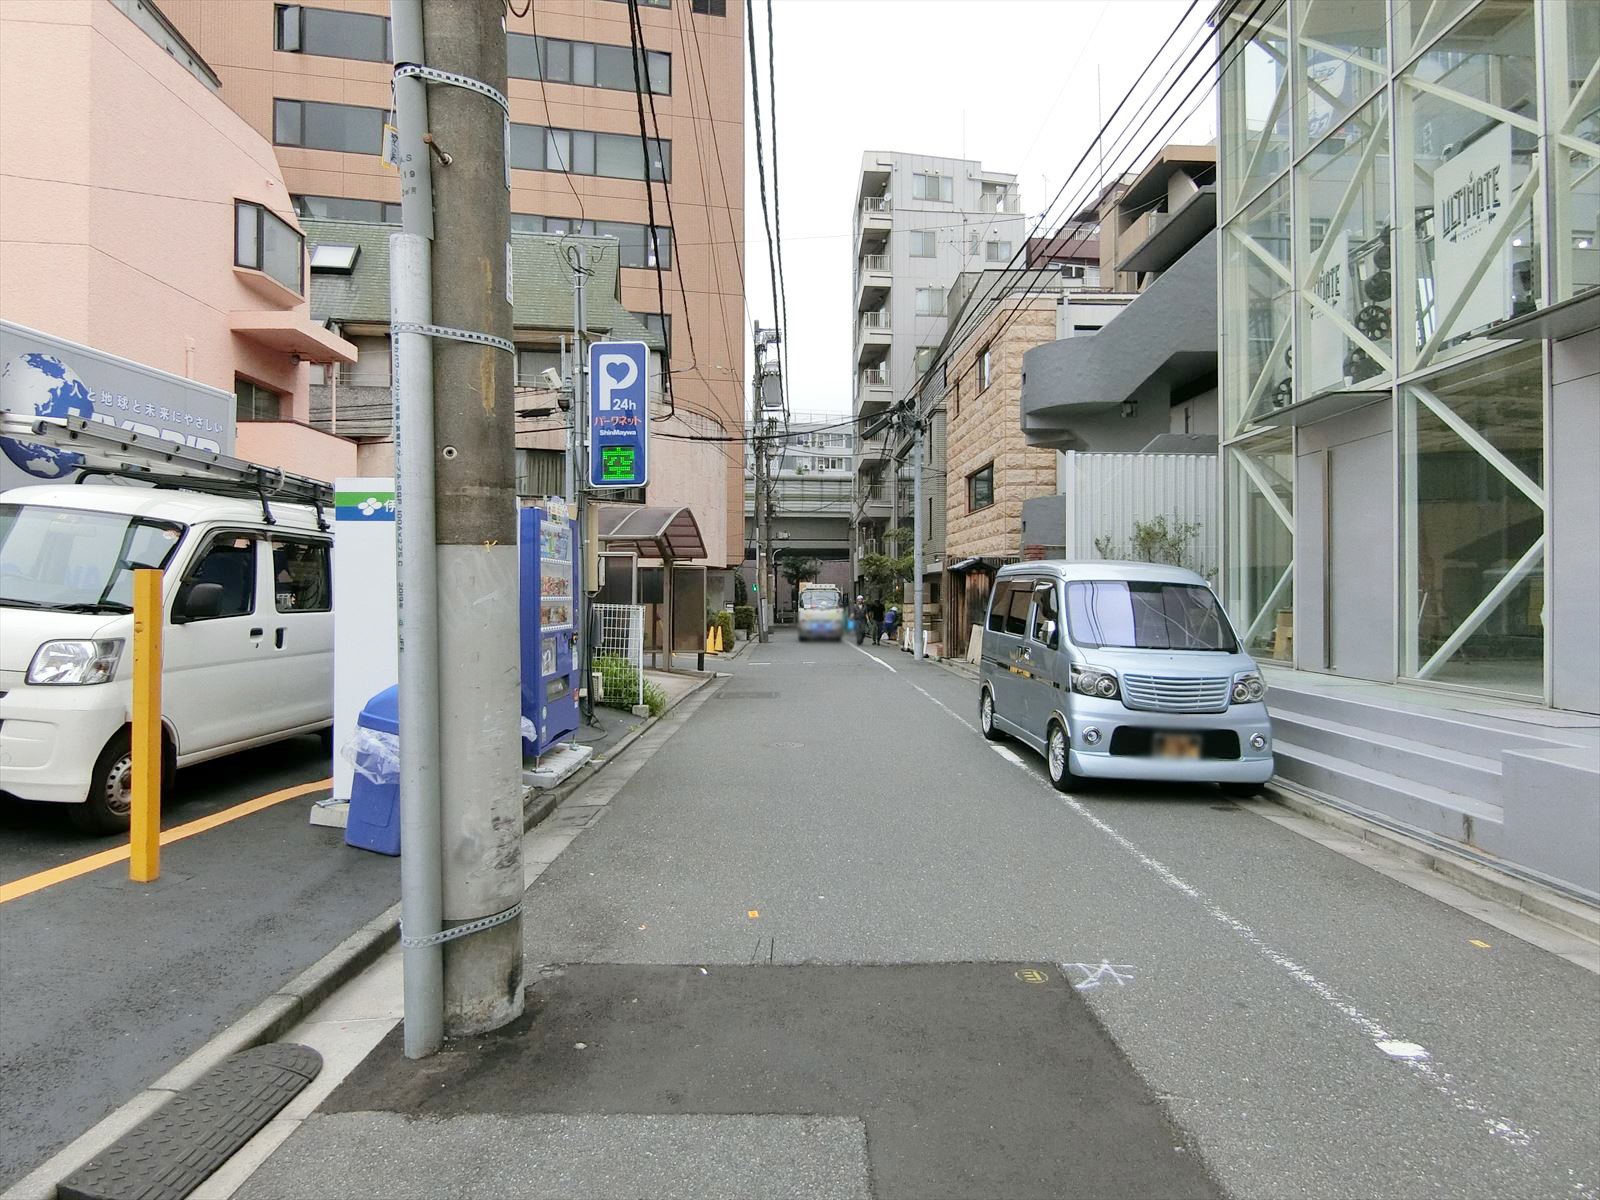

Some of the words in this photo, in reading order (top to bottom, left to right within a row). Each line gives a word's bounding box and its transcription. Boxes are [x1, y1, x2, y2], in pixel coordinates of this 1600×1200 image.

[1442, 165, 1501, 239] ULTIMATE
[69, 382, 224, 433] 人と地球と未来にやさしい
[612, 398, 637, 411] 24h
[599, 429, 637, 437] ShinMaywa
